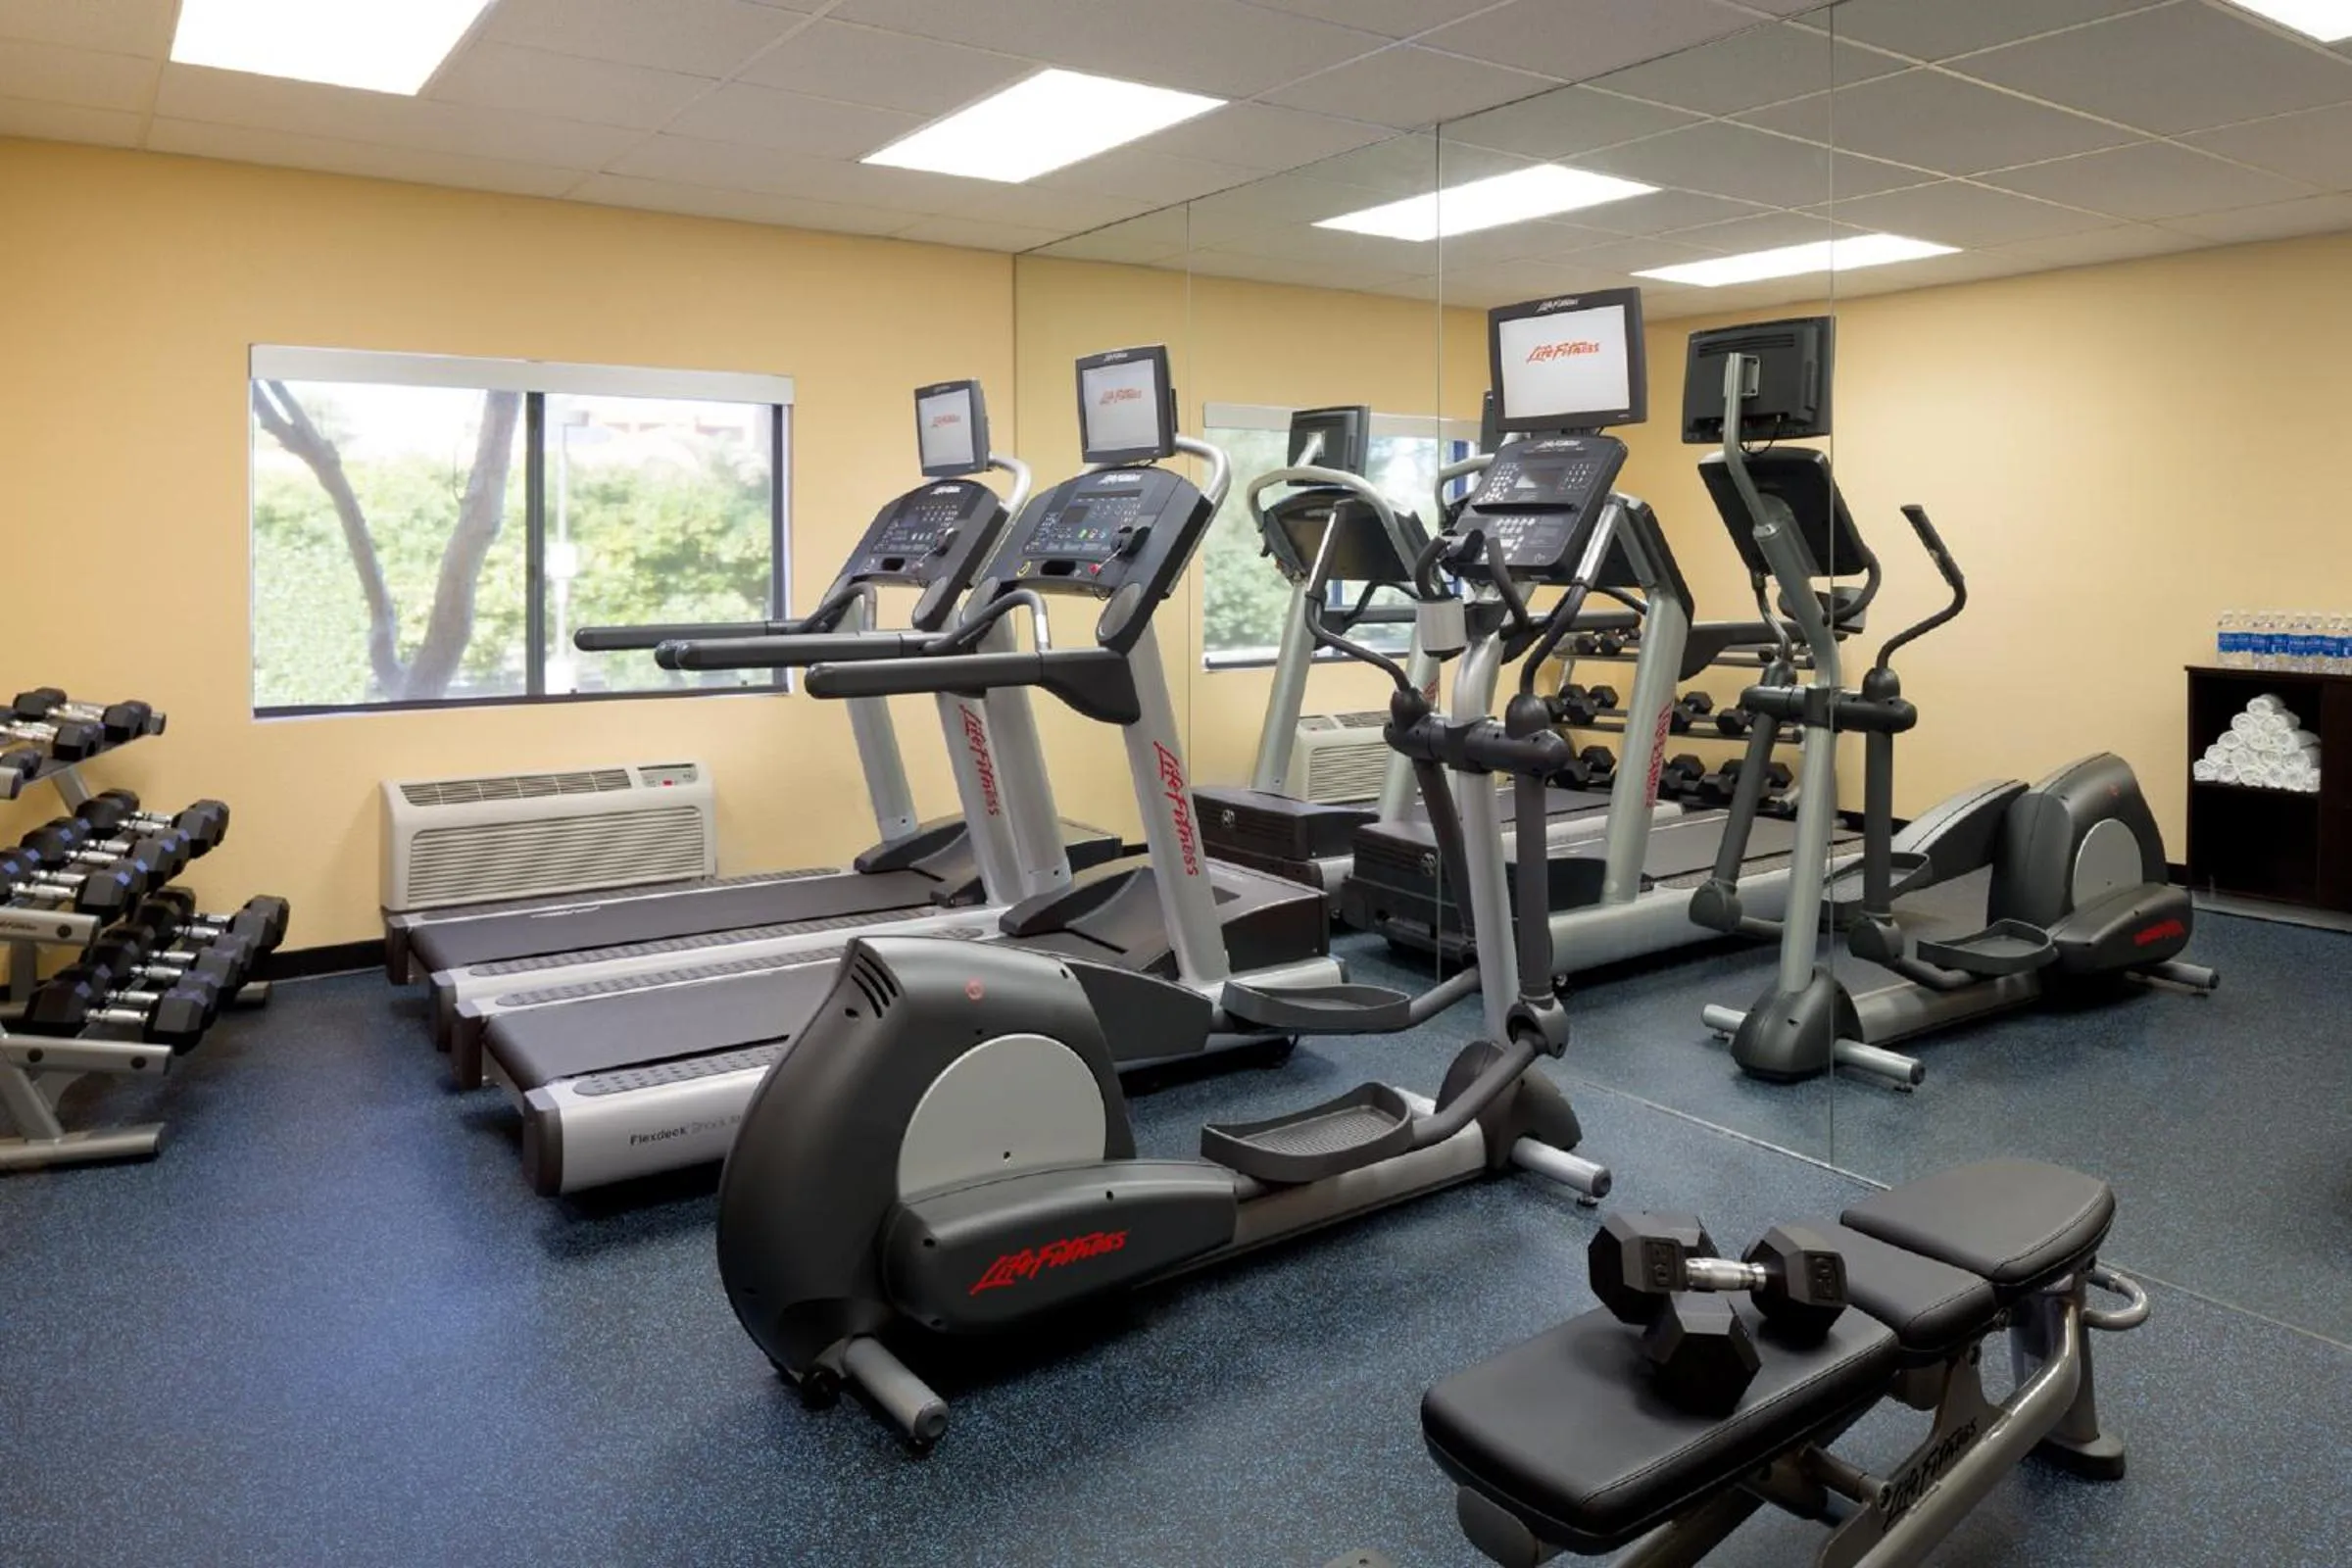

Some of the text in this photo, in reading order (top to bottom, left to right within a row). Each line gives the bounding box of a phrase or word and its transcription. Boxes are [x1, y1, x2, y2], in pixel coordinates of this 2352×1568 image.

[1152, 740, 1200, 876] Life Fitness
[629, 1126, 688, 1146] Flexdeck
